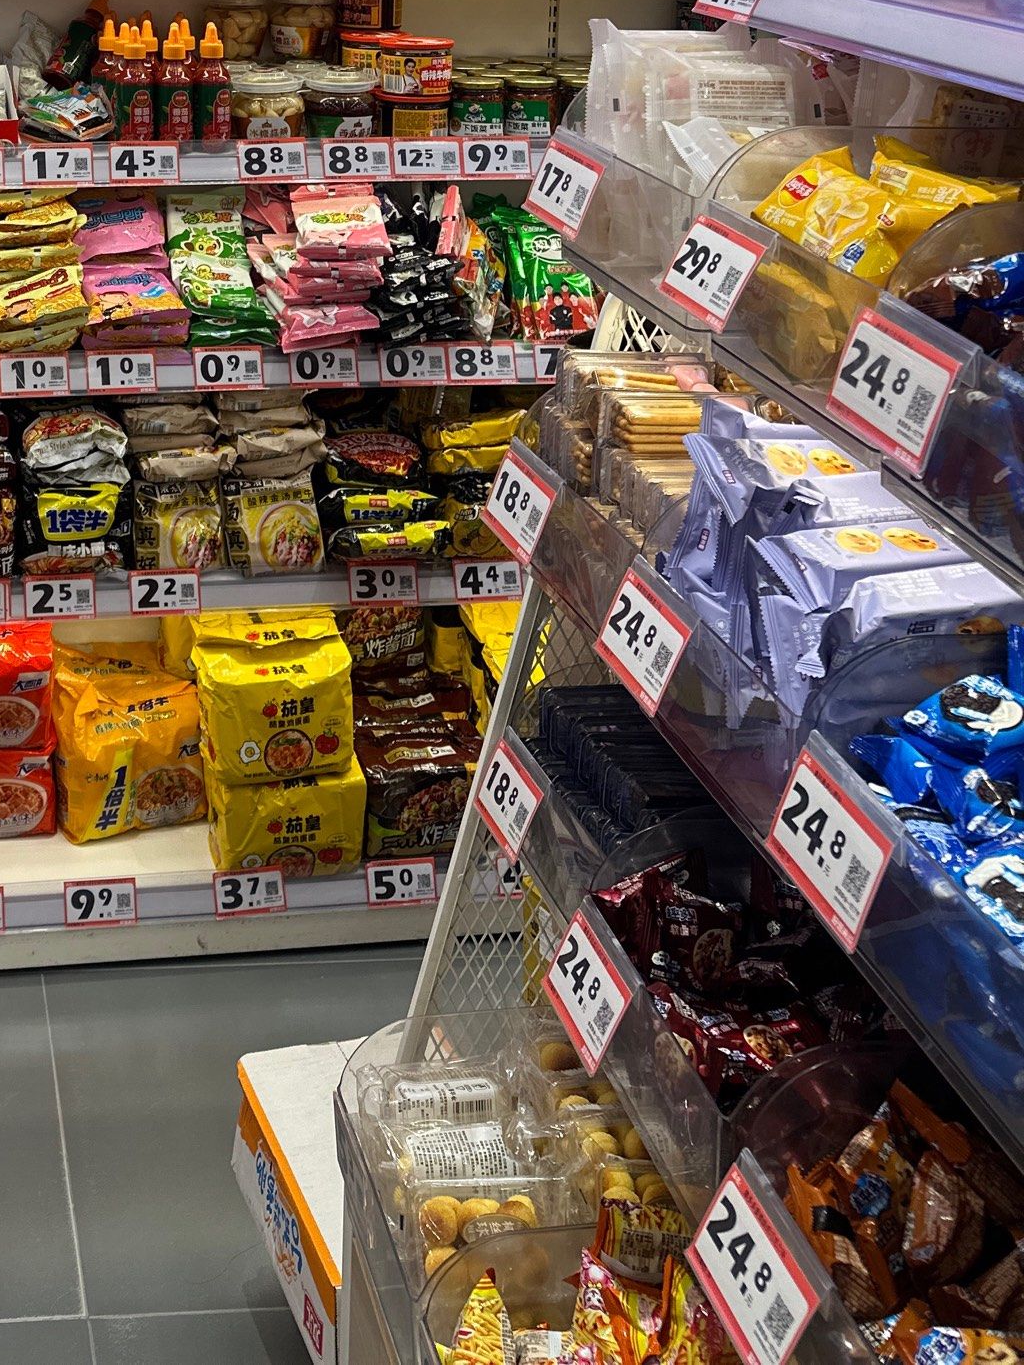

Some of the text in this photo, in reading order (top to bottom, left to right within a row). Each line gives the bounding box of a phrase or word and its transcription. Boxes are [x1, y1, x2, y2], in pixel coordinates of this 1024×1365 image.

[32, 151, 69, 179] 1.7
[115, 150, 155, 178] 4.5
[244, 147, 284, 175] 8.8
[329, 146, 368, 174] 8.8
[397, 149, 433, 167] 12.5
[468, 145, 507, 172] 9.9
[538, 162, 572, 204] 17.8
[673, 238, 721, 288] 29.8
[11, 360, 46, 389] 1.0
[97, 357, 133, 385] 1.0
[200, 354, 240, 382] 0.9
[296, 352, 335, 380] 0.9
[386, 350, 425, 377] 0.9
[455, 348, 494, 376] 8.8
[840, 338, 910, 403] 24.8
[495, 471, 530, 517] 18.8
[47, 509, 109, 533] 1袋半
[138, 578, 177, 607] 2.2
[356, 569, 395, 598] 3.0
[460, 566, 499, 594] 4.4
[32, 584, 72, 612] 2.5
[609, 594, 656, 655] 24.8
[365, 628, 417, 660] 炸酱面
[280, 697, 315, 716] 茄皇
[94, 765, 129, 832] 1倍半
[486, 761, 519, 813] 18.8
[286, 815, 321, 834] 茄皇
[781, 781, 846, 868] 24.8
[221, 878, 259, 909] 3.7
[374, 869, 413, 899] 5.0
[71, 888, 113, 919] 9.9
[556, 935, 602, 1007] 24.8
[707, 1196, 773, 1296] 24.8
